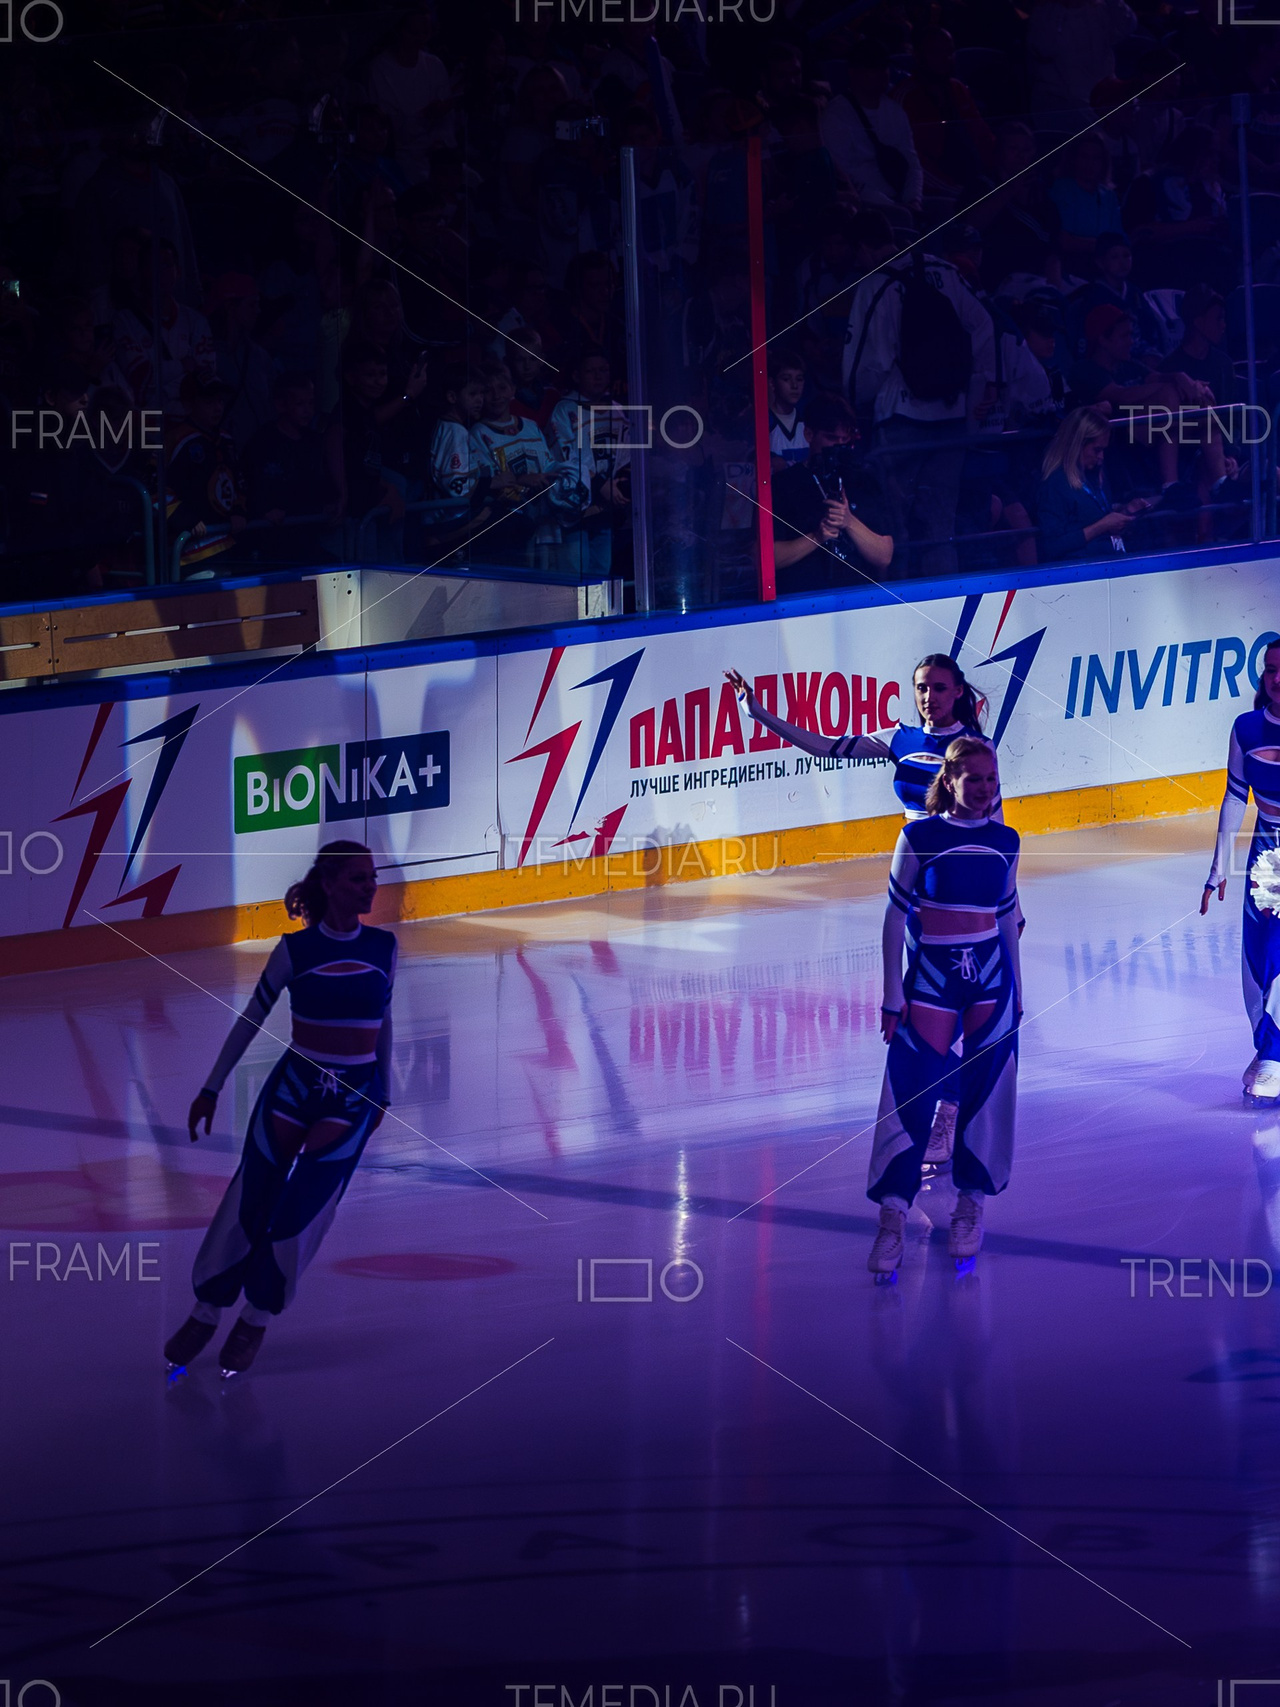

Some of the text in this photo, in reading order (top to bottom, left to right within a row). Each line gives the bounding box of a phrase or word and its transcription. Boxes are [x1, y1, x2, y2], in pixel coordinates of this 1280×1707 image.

[630, 680, 746, 770] ПАПА
[630, 756, 892, 798] ЛУЧШЕ ИНГРЕДИЕНТЫ. ЛУЧШЕ ПИЦЦ
